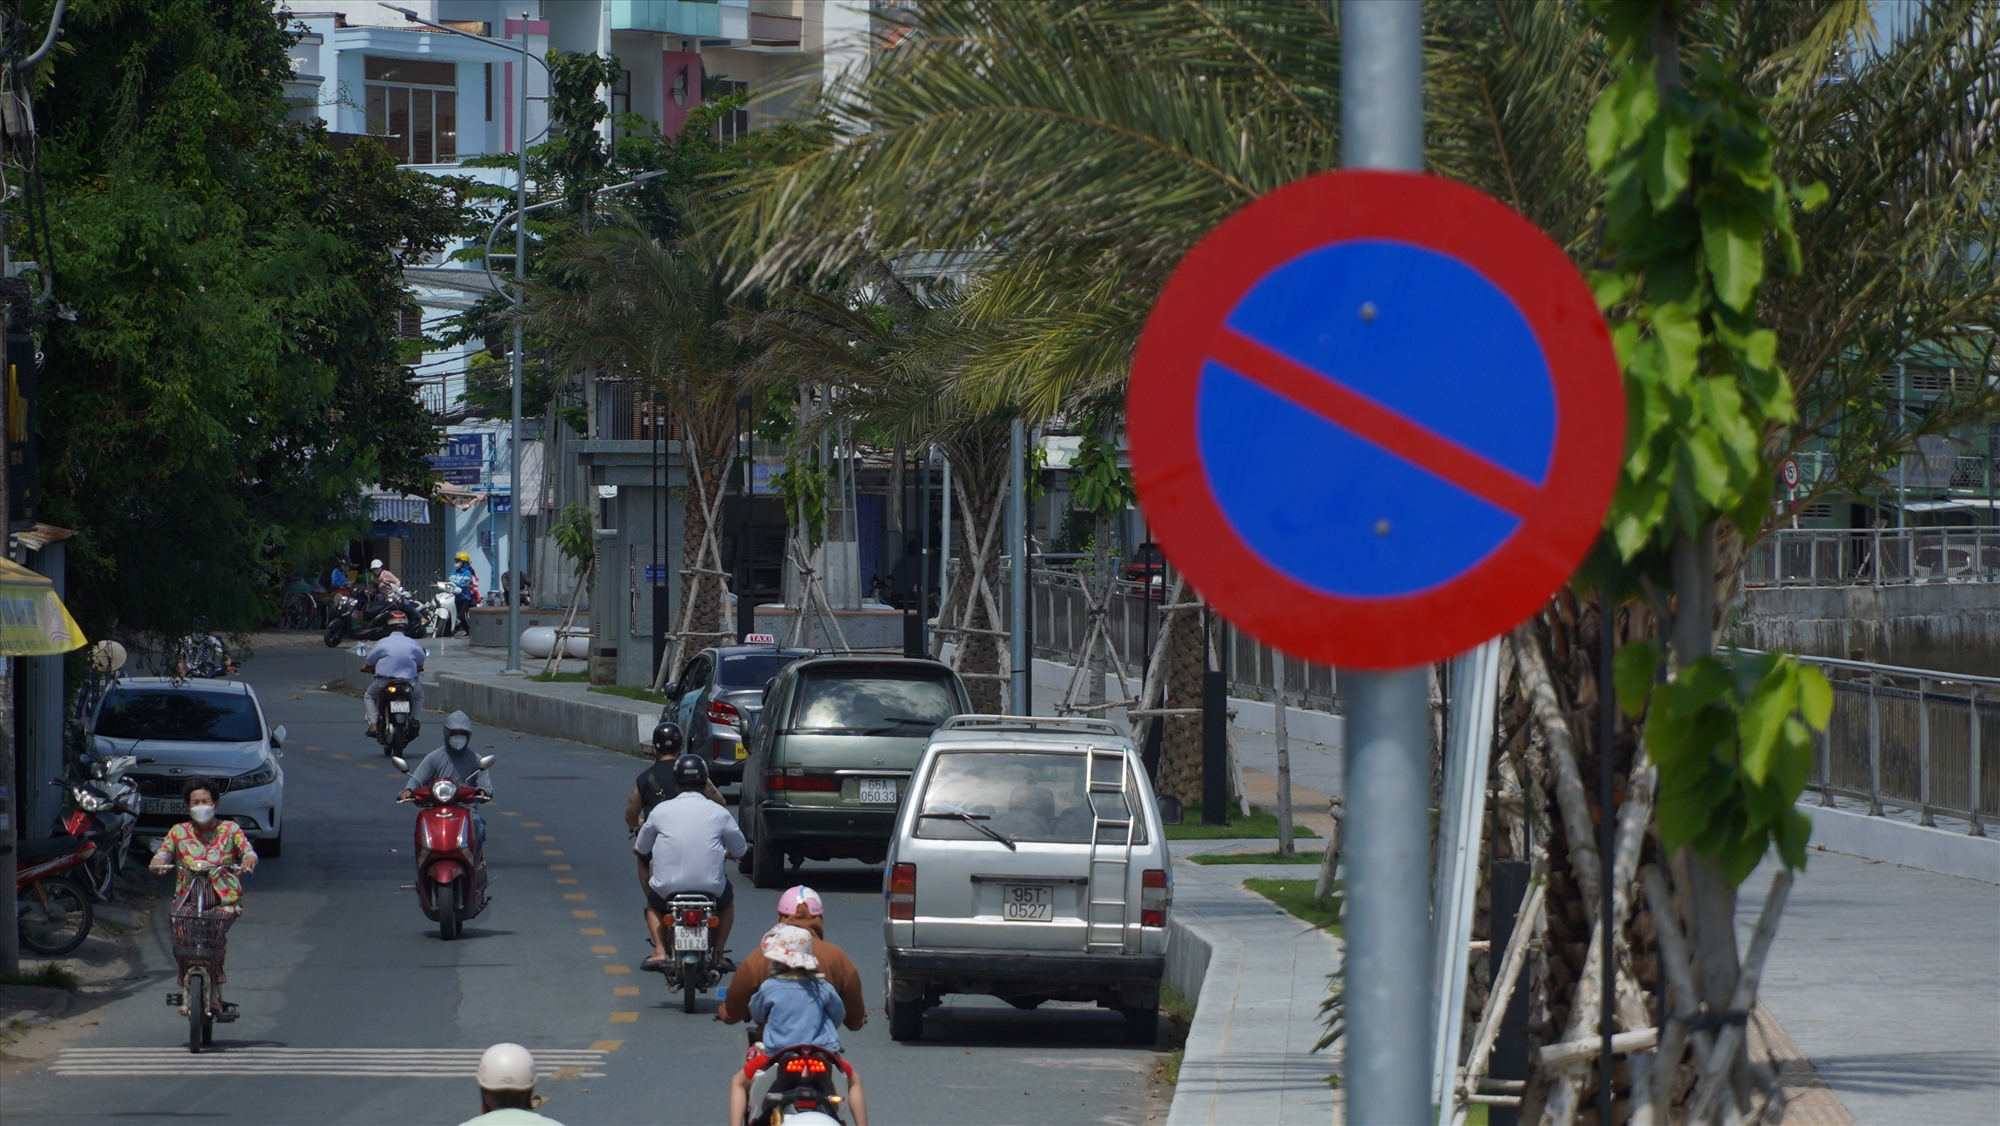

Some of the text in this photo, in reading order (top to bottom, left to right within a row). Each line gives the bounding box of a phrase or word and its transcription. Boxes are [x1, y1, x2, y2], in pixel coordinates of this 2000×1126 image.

[455, 443, 476, 456] 107
[750, 635, 772, 643] TAXI
[868, 779, 888, 791] 65A
[861, 790, 896, 802] 050.33
[1014, 887, 1043, 903] 95T
[1009, 903, 1047, 919] 0527
[677, 939, 707, 949] 018.26
